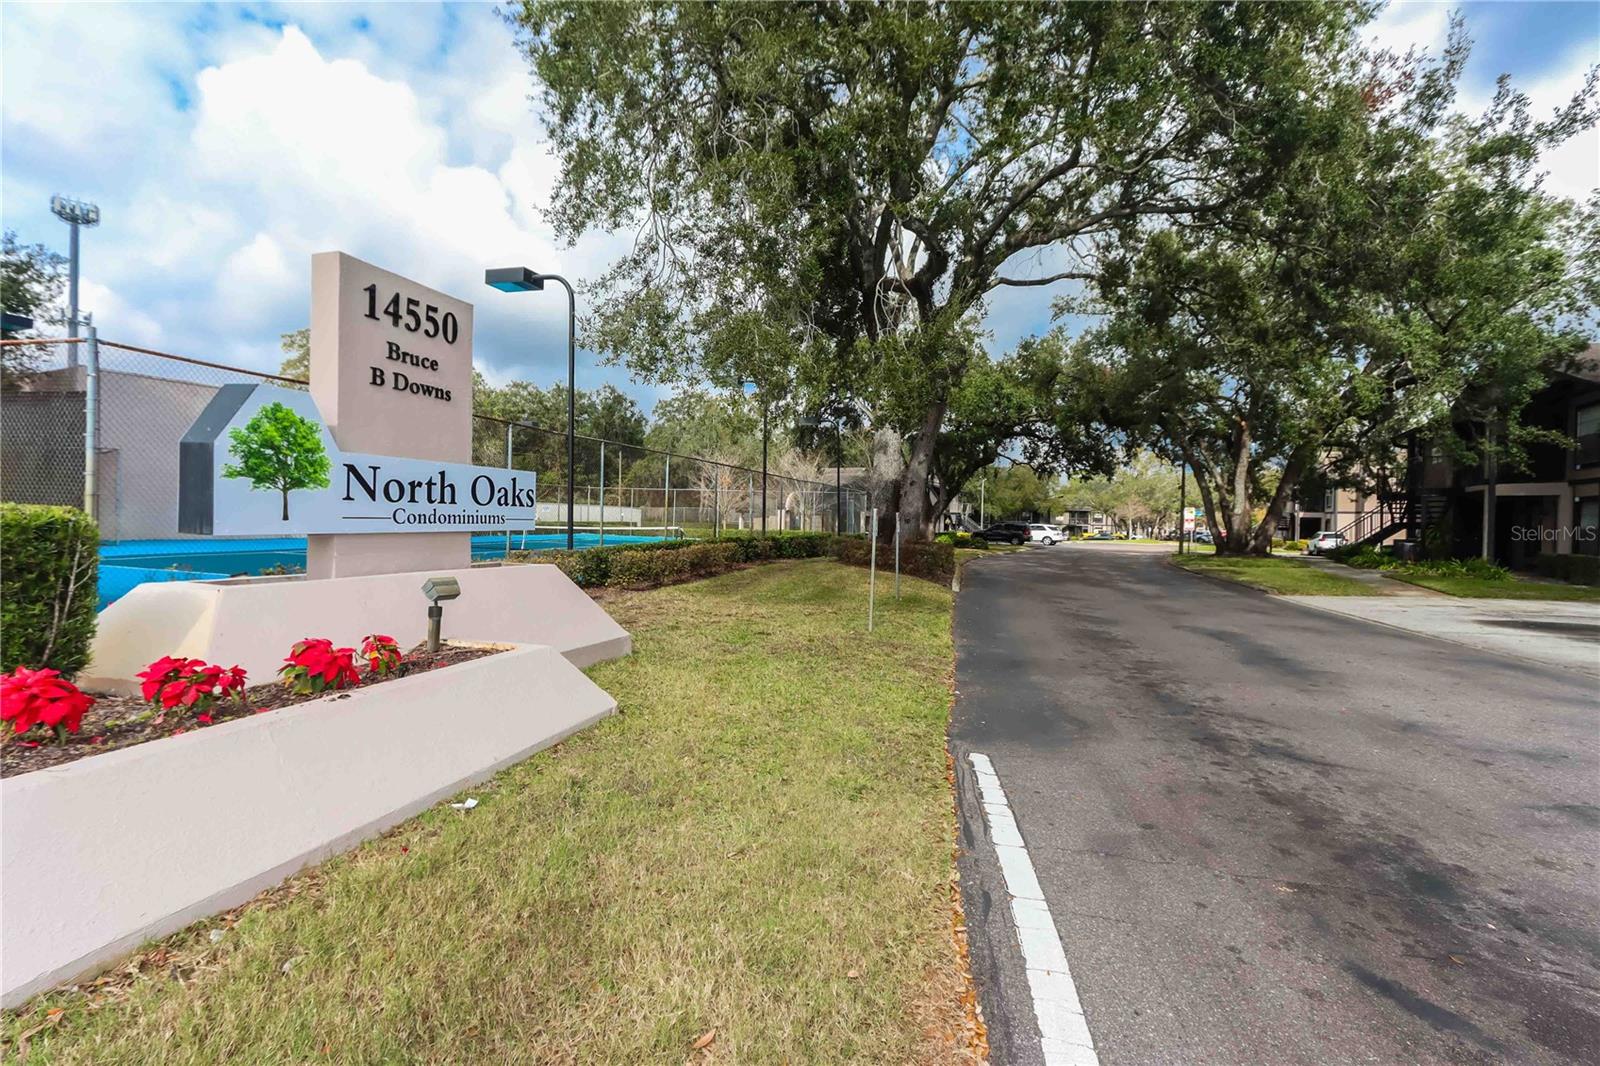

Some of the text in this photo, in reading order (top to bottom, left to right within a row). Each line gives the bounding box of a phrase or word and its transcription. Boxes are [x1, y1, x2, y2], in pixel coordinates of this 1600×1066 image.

[363, 283, 458, 345] 14550
[386, 341, 439, 371] Bruce
[370, 367, 451, 401] B Downs
[342, 464, 535, 508] North Oaks
[392, 507, 506, 525] Condominiums
